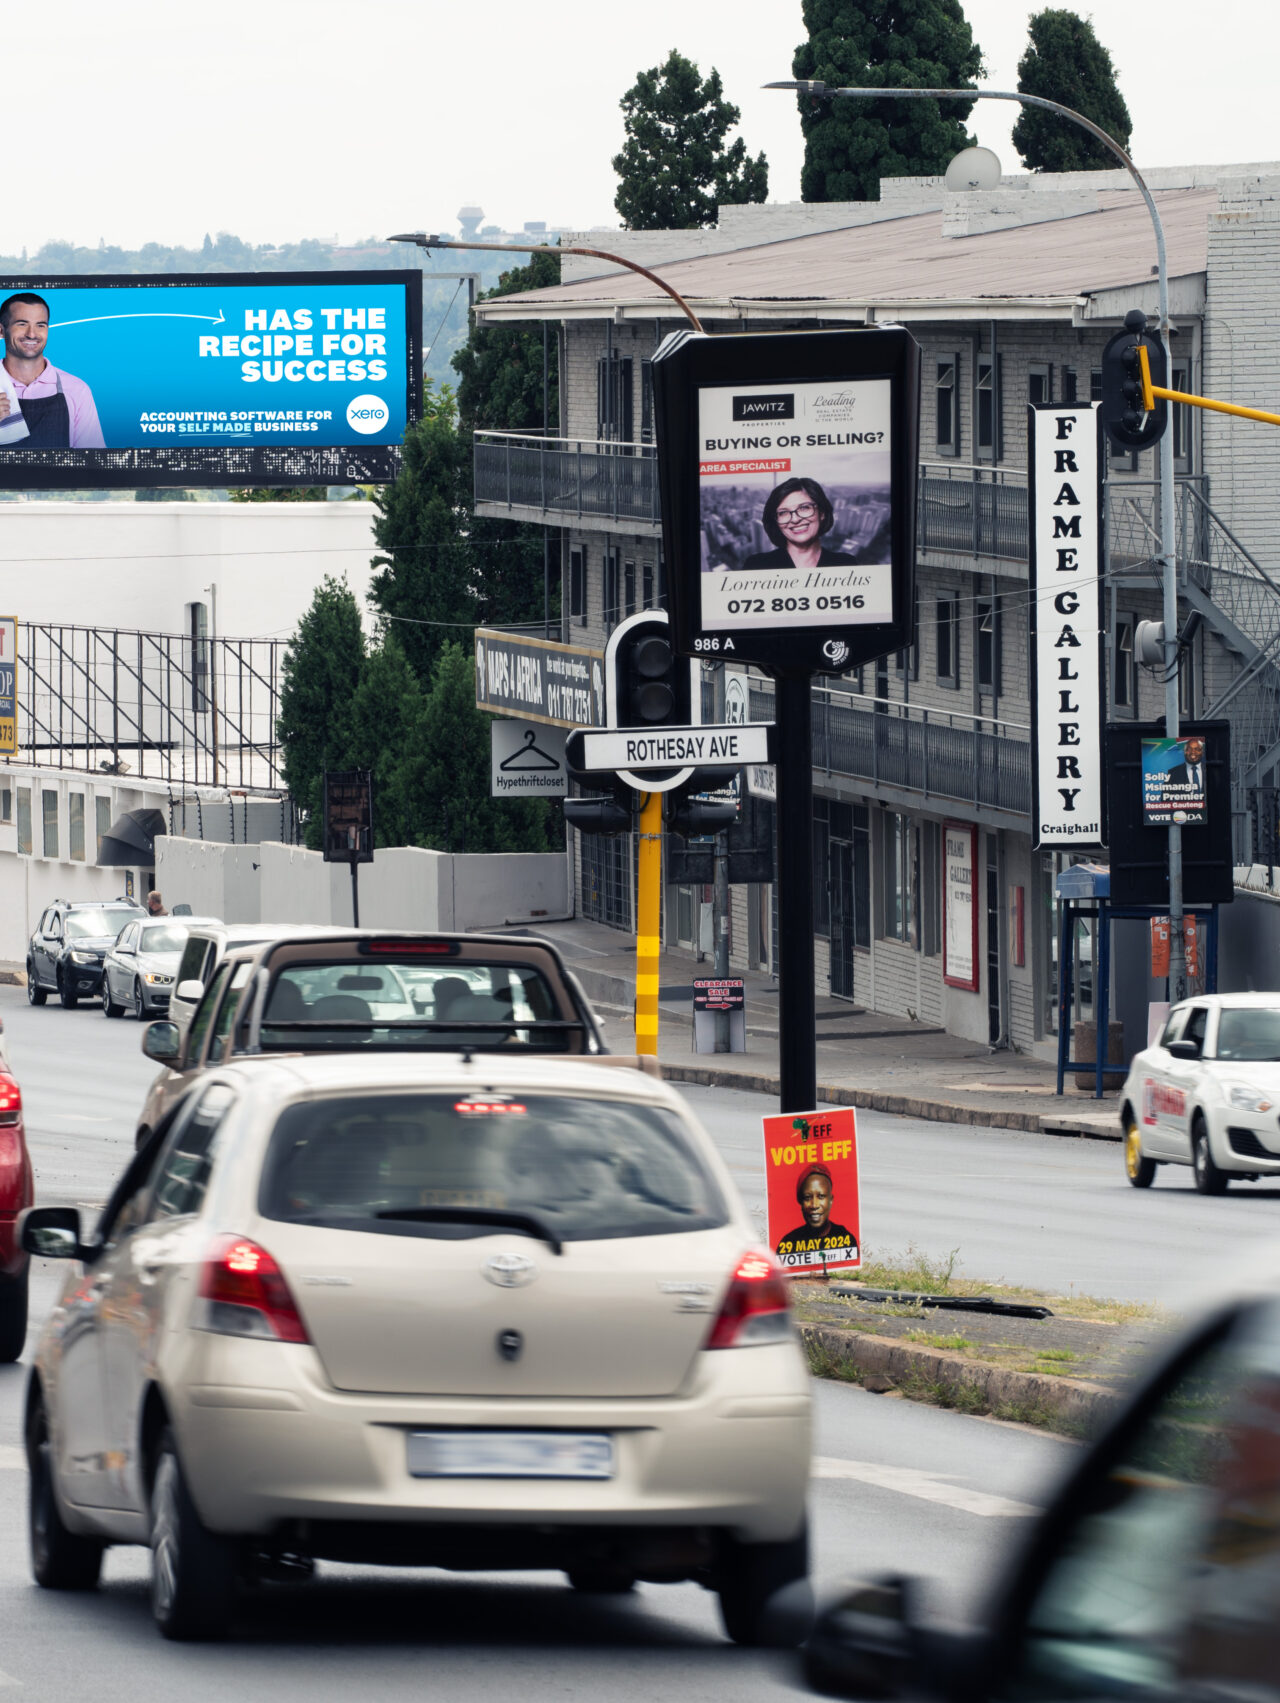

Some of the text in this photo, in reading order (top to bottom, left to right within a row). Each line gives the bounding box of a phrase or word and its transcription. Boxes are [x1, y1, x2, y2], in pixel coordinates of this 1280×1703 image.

[245, 308, 386, 331] HAS THE
[199, 334, 387, 357] RECIPE FOR
[241, 360, 388, 382] SUCCESS
[812, 390, 856, 409] Leading
[140, 411, 333, 421] ACCOUNTING SOFTWARE FOR
[350, 407, 385, 420] xero
[742, 402, 786, 415] JAWITZ
[140, 422, 319, 433] YOUR SELF MADE BUSINESS
[705, 432, 885, 451] BUYING OR SELLING?
[700, 461, 787, 473] AREA SPECIALIST
[1053, 416, 1082, 572] FRAME
[720, 570, 872, 592] Lorraine Hurdus
[727, 595, 865, 614] 072 803 0516
[694, 637, 735, 651] 986 A
[488, 650, 543, 705] MAPS 4 AFRICA
[548, 683, 561, 718] 011
[575, 688, 592, 725] 2751
[1054, 591, 1082, 812] GALLERY
[627, 735, 738, 761] ROTHESAY AVE
[496, 775, 564, 790] Hypethriftcloset
[1145, 773, 1171, 782] Solly
[1145, 783, 1199, 791] Msimanga
[1145, 793, 1204, 801] for Premier
[1041, 823, 1099, 835] Craighall
[694, 980, 743, 988] CLEARANCE
[813, 1124, 833, 1138] EFF
[770, 1140, 852, 1166] VOTE EFF
[778, 1235, 851, 1254] 29 MAY 2024
[779, 1252, 812, 1266] VOTE
[827, 1253, 837, 1261] EFF
